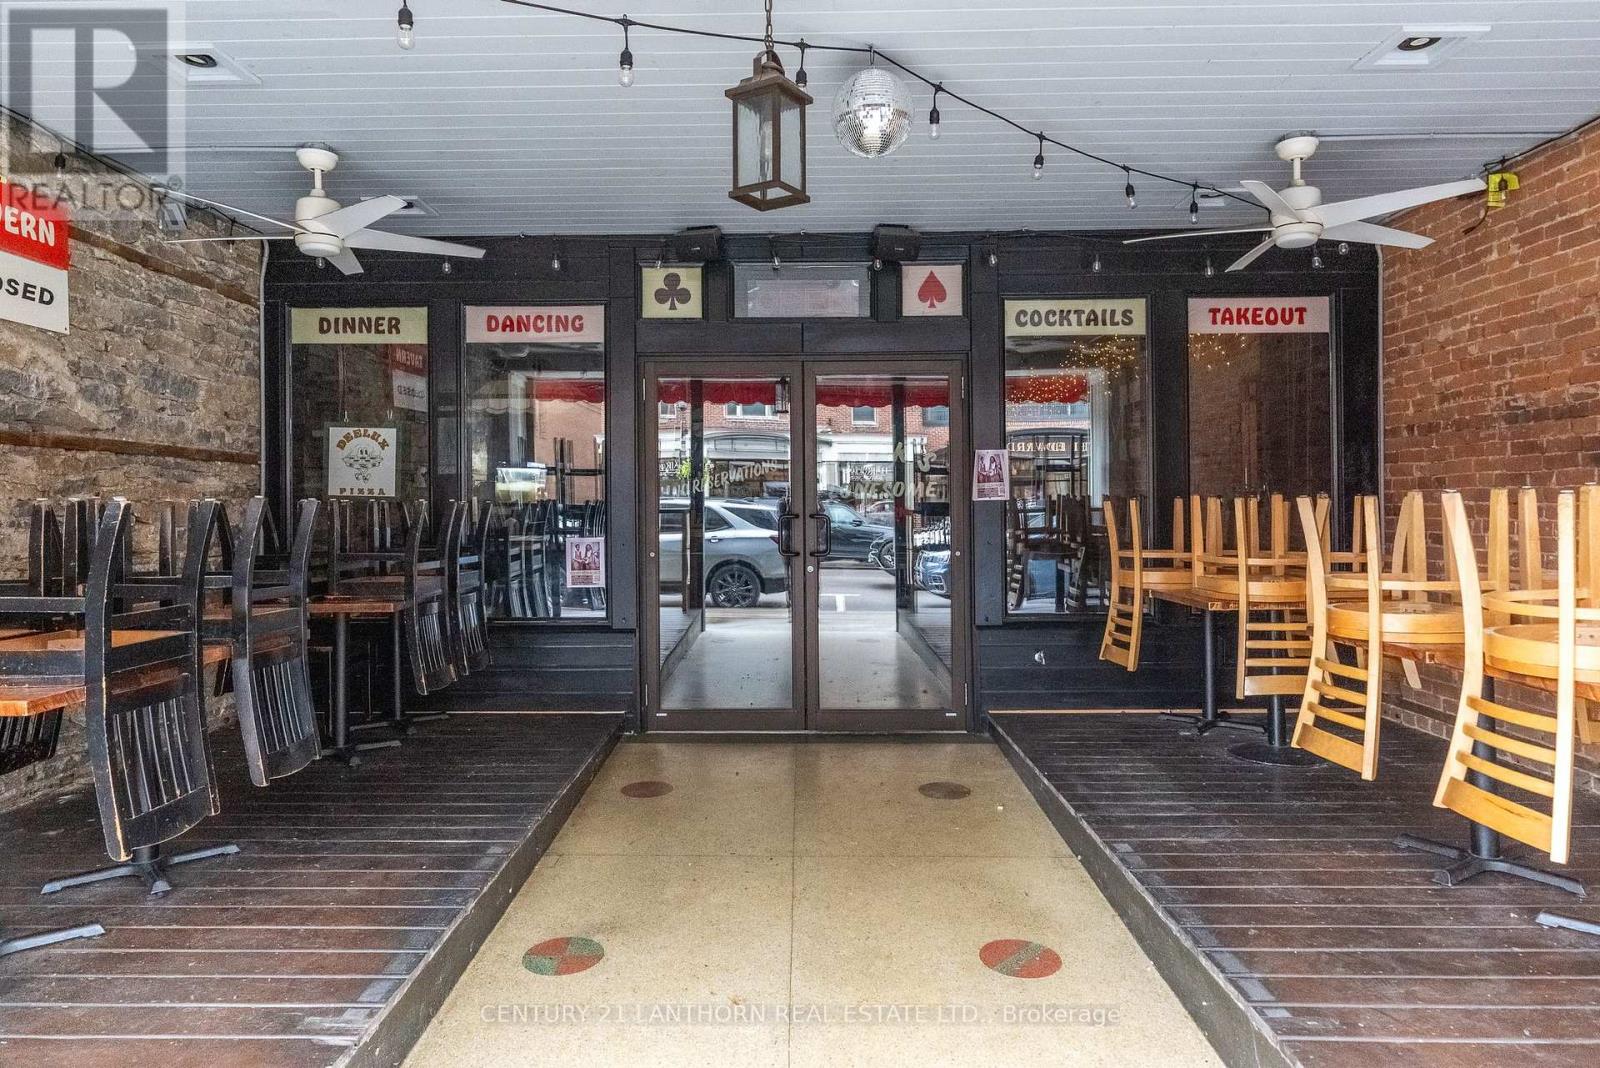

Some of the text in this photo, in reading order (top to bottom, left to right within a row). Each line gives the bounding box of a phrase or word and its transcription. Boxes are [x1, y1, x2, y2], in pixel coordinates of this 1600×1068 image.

[0, 202, 56, 247] ERN
[0, 277, 55, 306] SED
[318, 316, 401, 335] DINNER
[486, 314, 585, 333] DANCING
[1014, 308, 1134, 328] COCKTAILS
[1208, 306, 1308, 326] TAKEOUT
[338, 487, 386, 496] PIZZA
